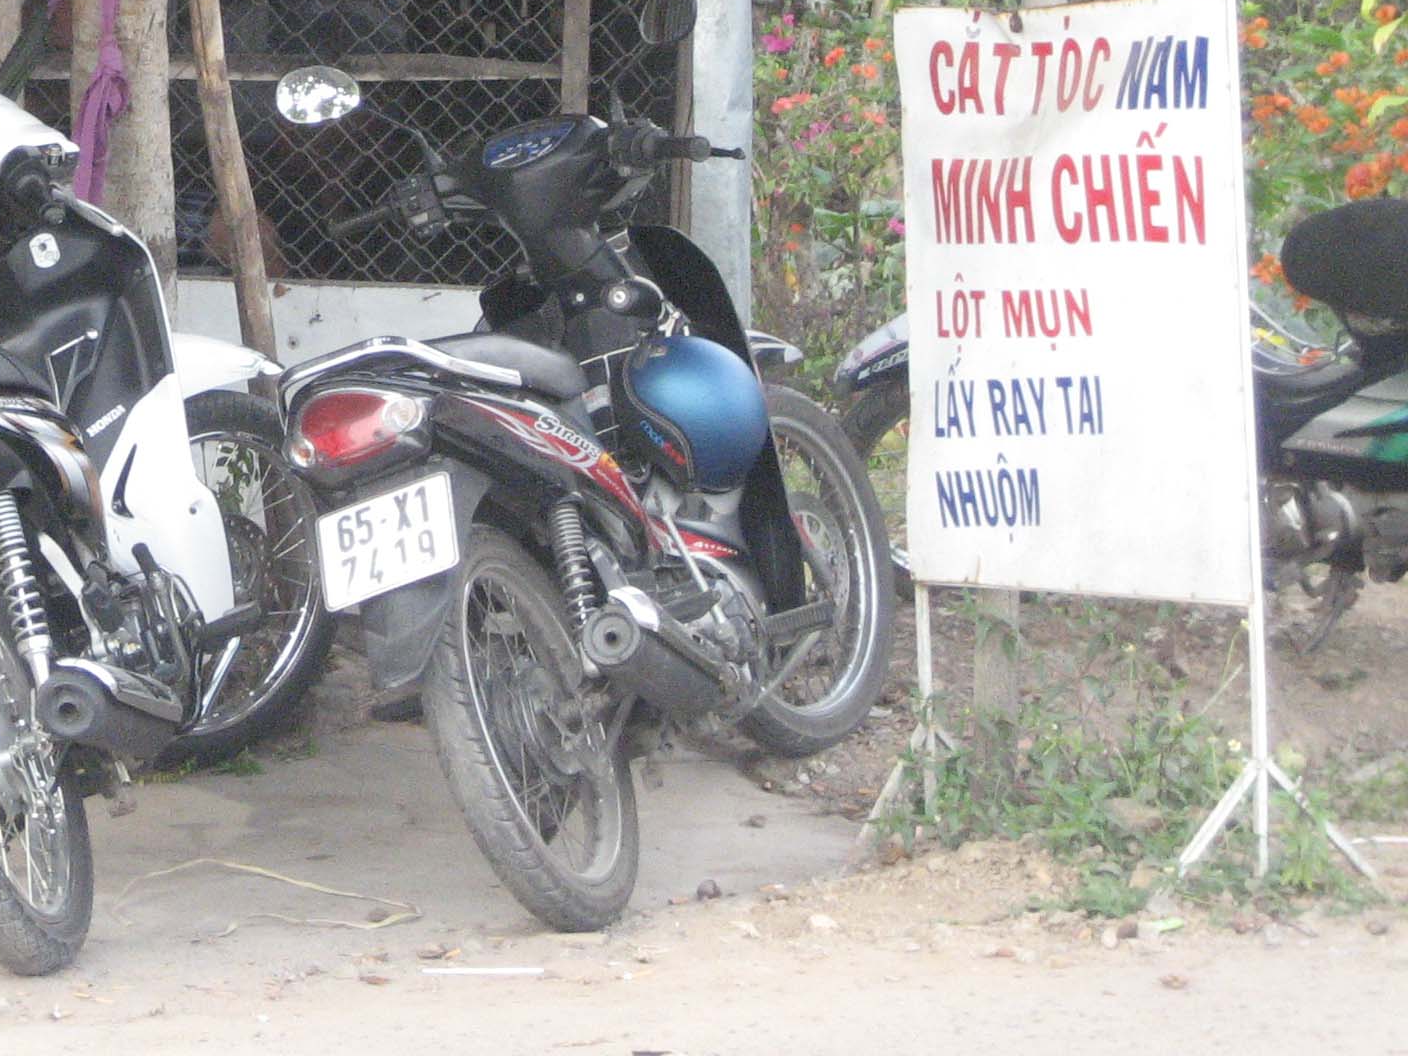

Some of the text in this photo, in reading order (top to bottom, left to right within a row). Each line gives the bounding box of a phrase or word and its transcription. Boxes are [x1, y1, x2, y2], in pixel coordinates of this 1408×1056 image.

[1031, 15, 1111, 115] TÓC
[1115, 35, 1209, 110] NAM
[931, 122, 1207, 246] MINH CHIẾN
[935, 272, 1093, 353] LỘT MỤN
[85, 404, 127, 438] HONDA
[934, 356, 976, 438] LẤY
[1055, 375, 1104, 435] TAI
[935, 452, 1041, 544] NHUỘM
